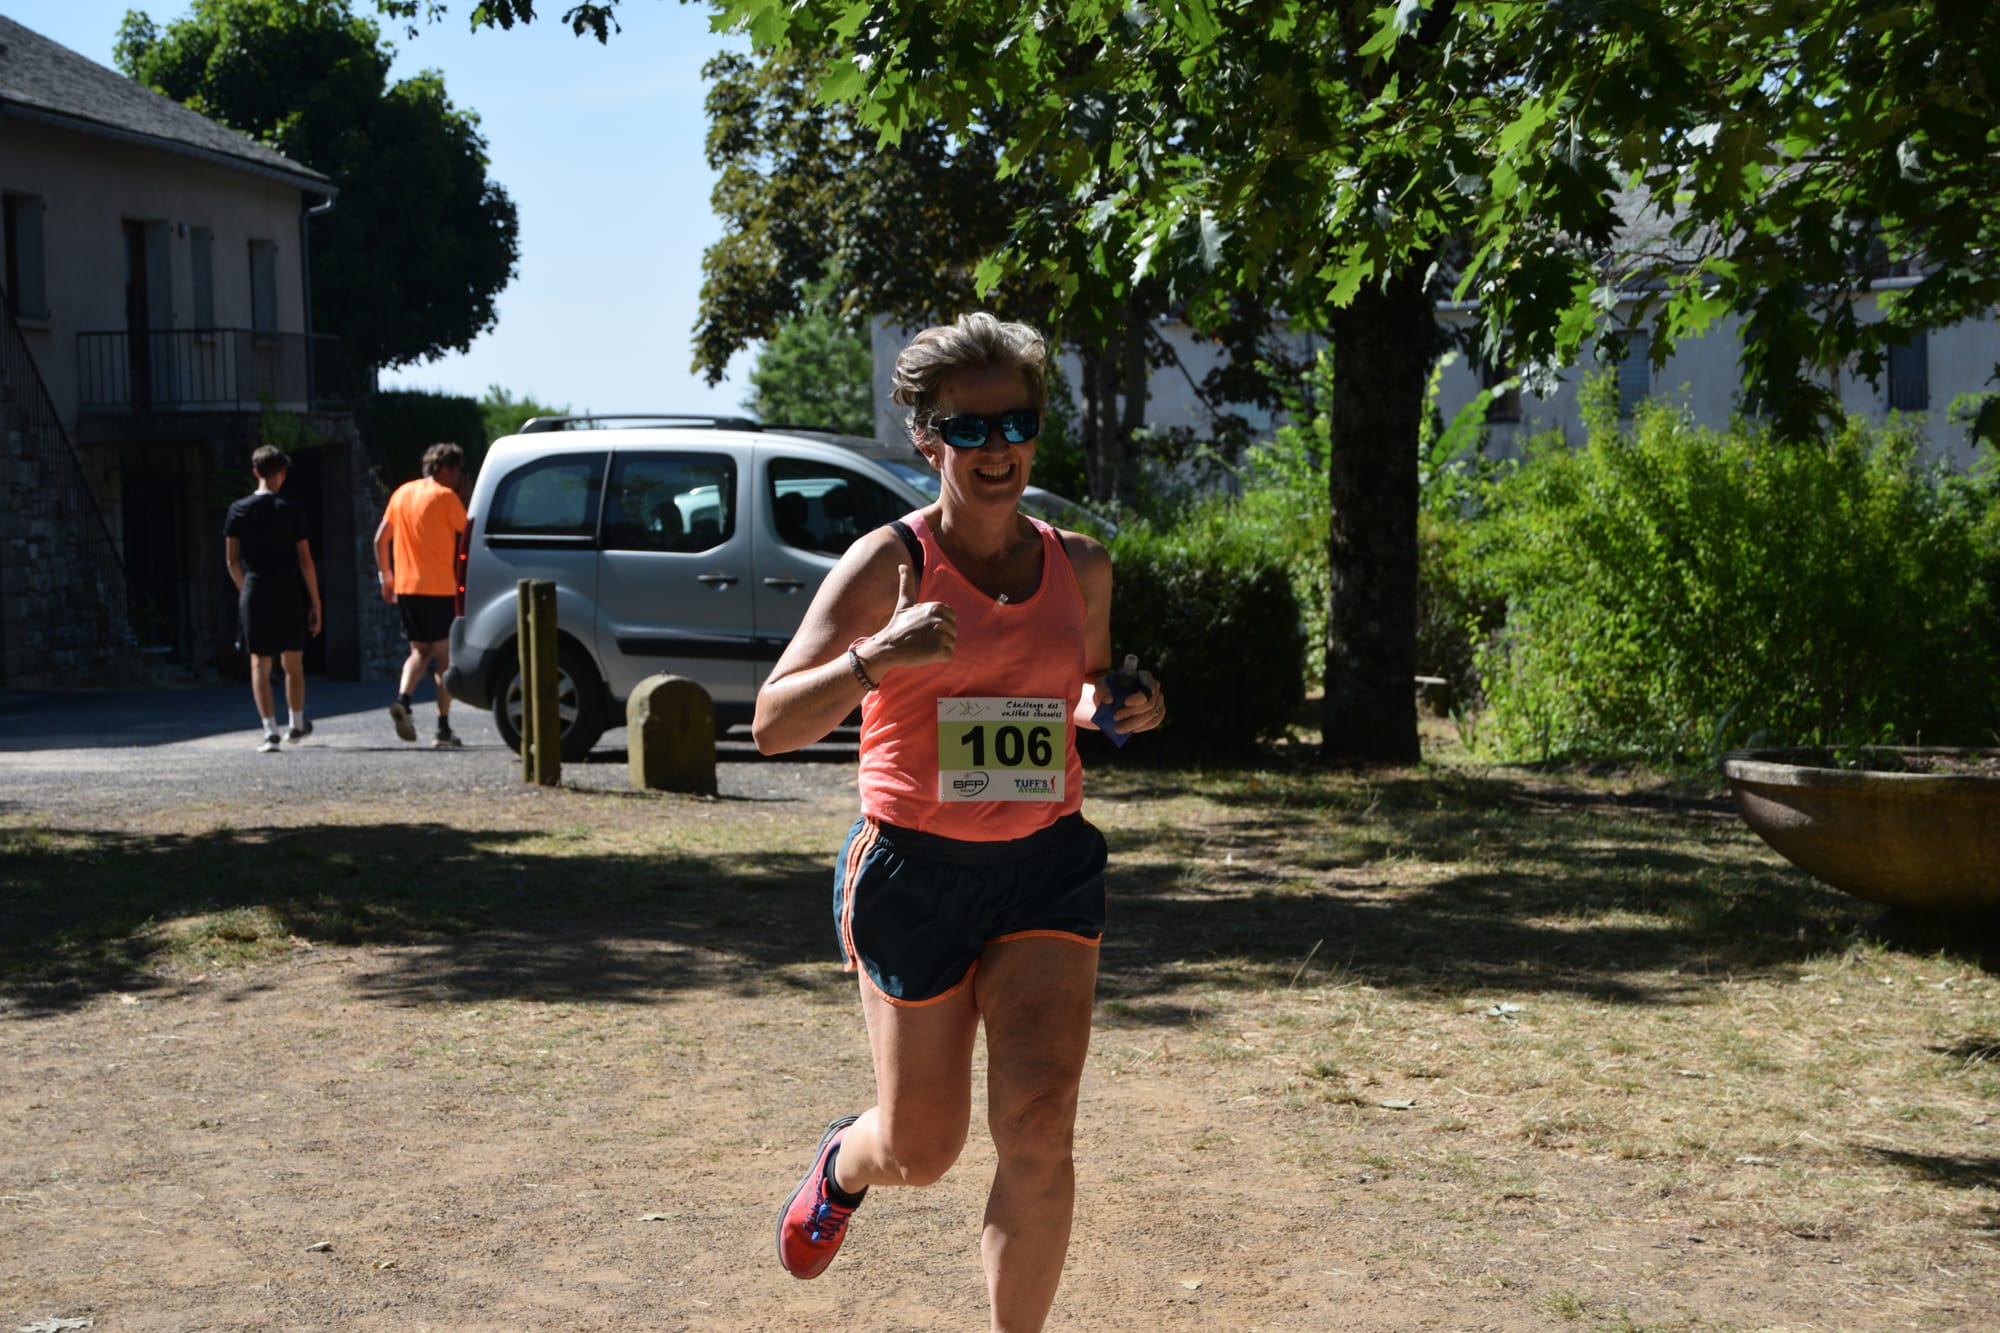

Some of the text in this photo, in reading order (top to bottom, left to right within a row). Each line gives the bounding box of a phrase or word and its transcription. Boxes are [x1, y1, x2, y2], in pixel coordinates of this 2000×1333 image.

[1006, 701, 1044, 711] Challenge
[961, 725, 1052, 767] 106
[953, 780, 984, 789] BFP
[1014, 779, 1048, 788] TUFF'S
